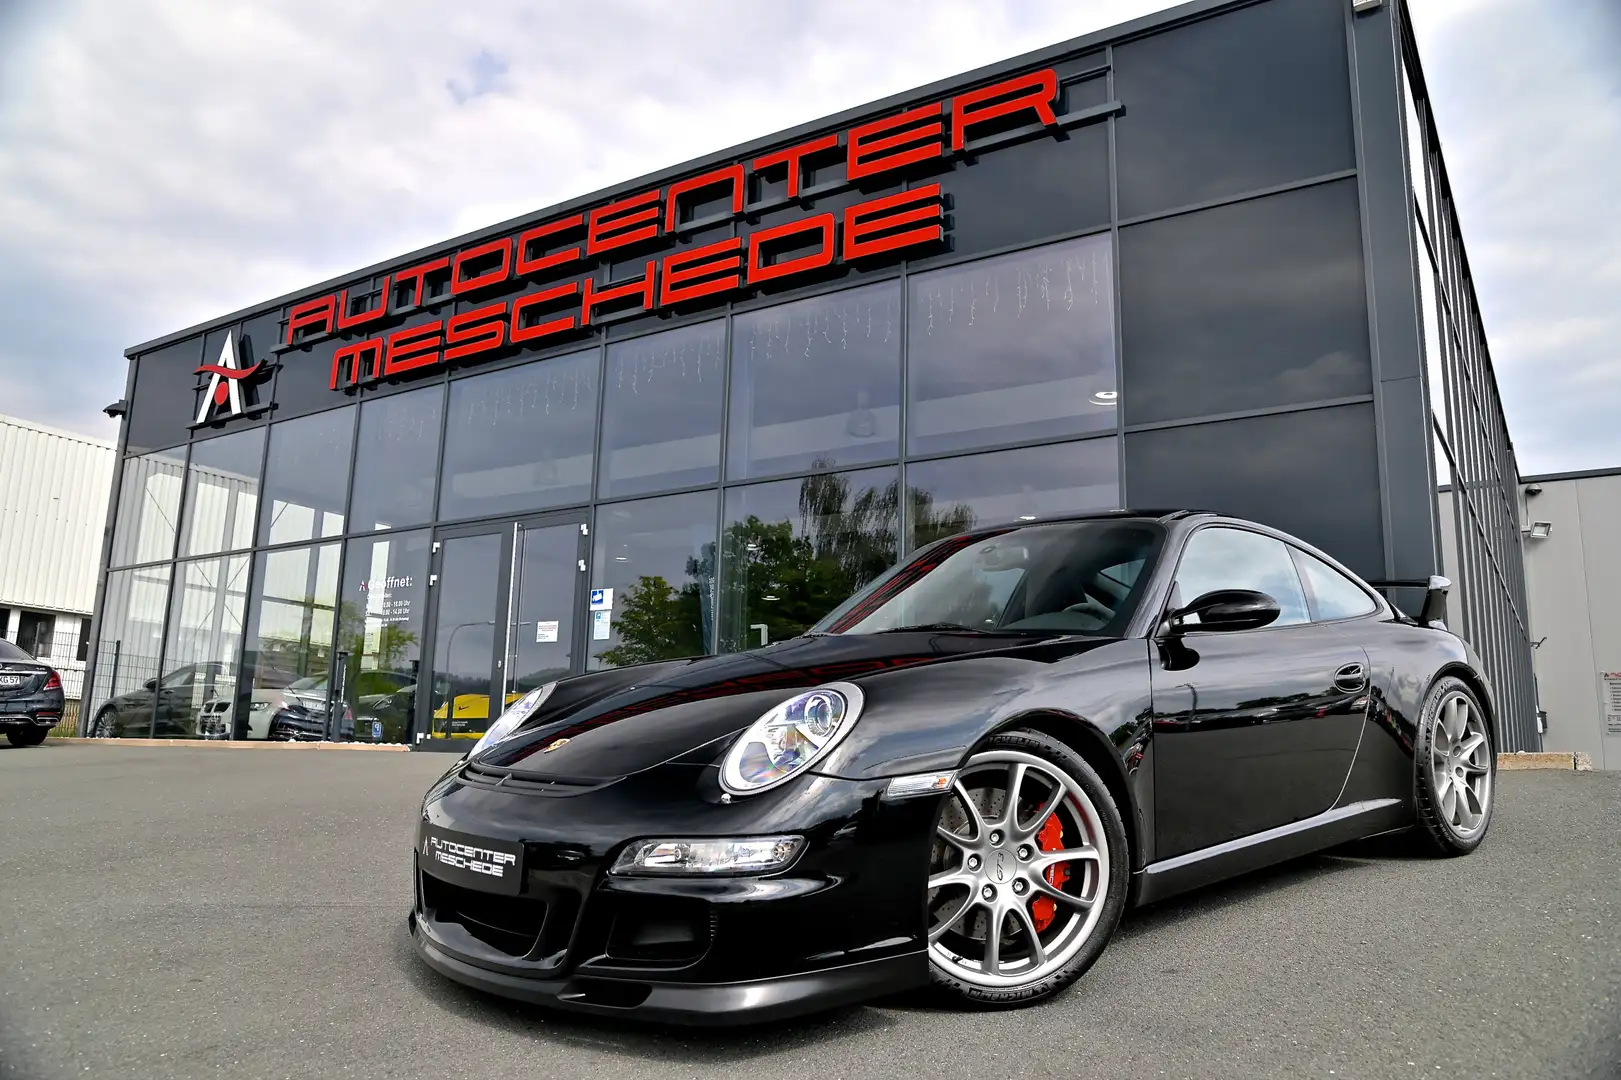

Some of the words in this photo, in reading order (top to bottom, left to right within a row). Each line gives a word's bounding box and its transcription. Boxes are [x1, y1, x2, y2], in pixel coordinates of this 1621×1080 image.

[287, 69, 1057, 346] AUTOCENTER
[329, 183, 941, 390] MESCHEDE
[988, 736, 1041, 749] ICHELIN
[430, 836, 516, 866] AUTOCENTER
[434, 850, 504, 878] MESCHEDE
